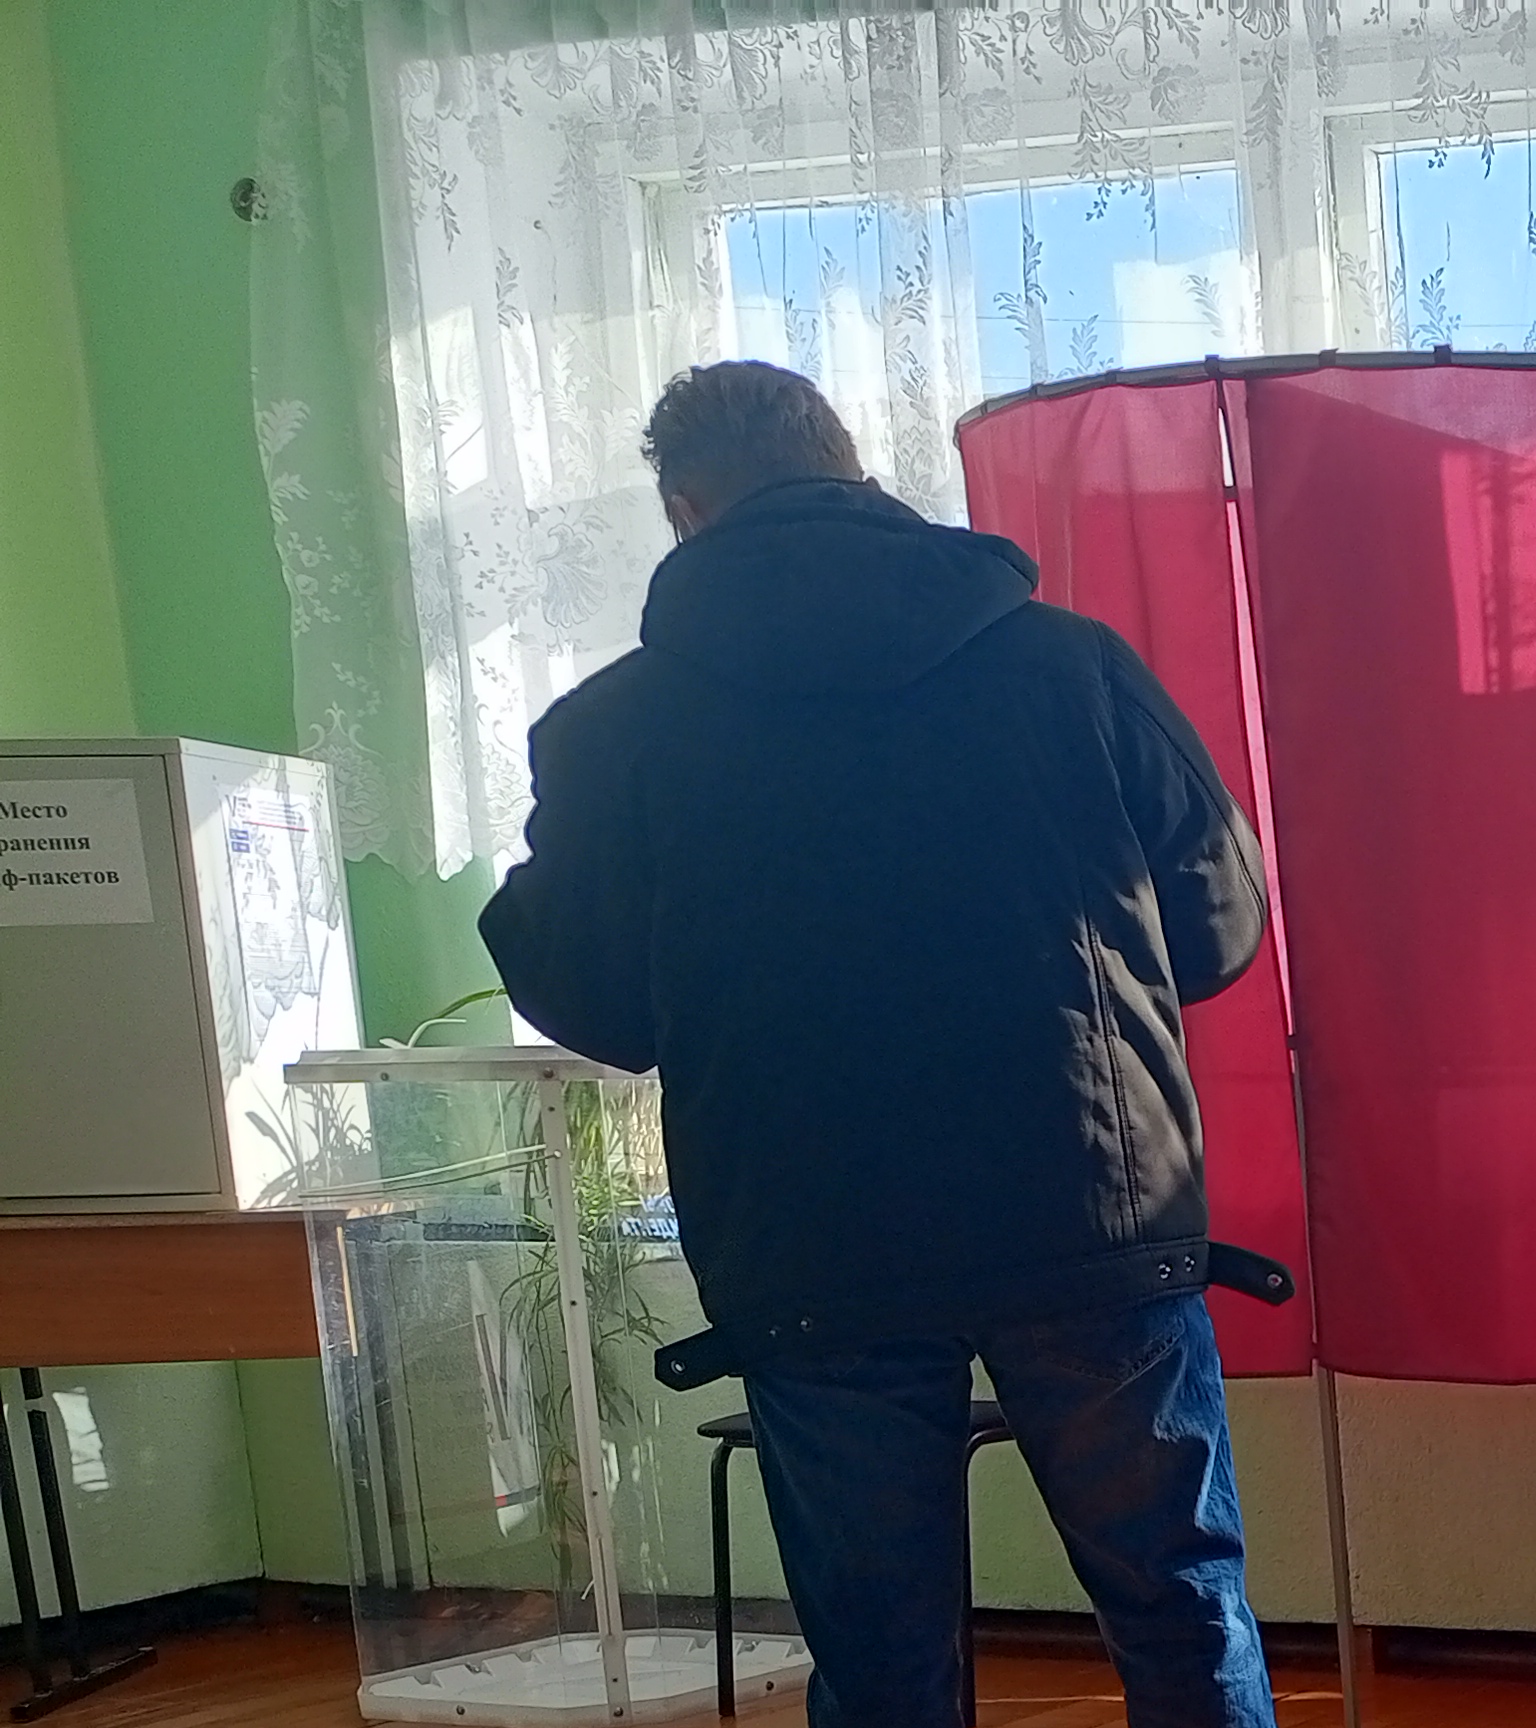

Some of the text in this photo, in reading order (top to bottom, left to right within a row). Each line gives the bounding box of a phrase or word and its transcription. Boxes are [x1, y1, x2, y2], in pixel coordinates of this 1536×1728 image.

[0, 801, 68, 819] Место
[0, 837, 91, 856] ранения
[0, 869, 120, 891] ф-пакетов
